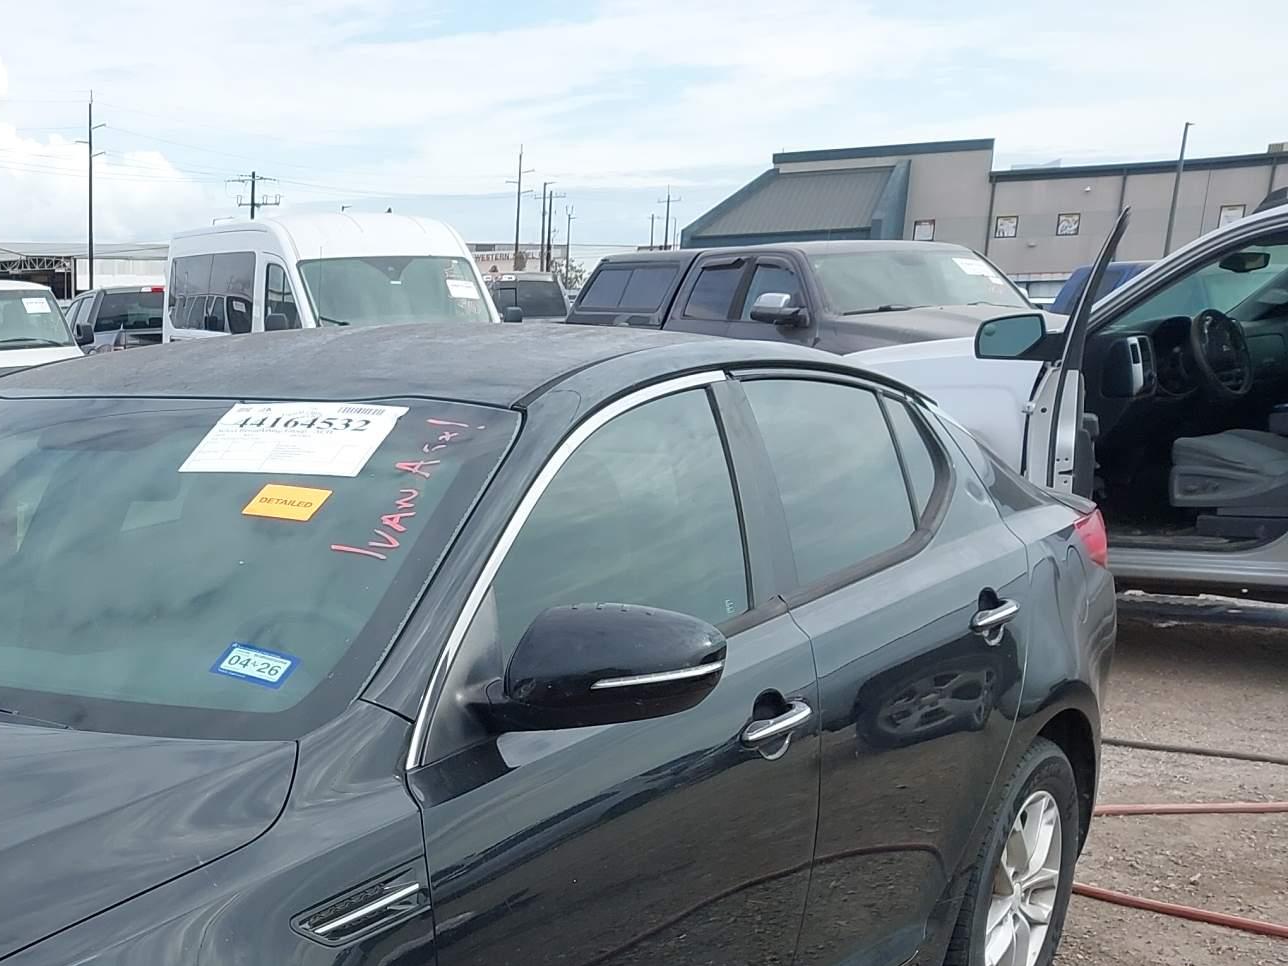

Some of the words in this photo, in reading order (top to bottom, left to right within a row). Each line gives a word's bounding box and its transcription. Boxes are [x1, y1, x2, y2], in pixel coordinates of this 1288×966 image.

[474, 251, 510, 261] WESTERN
[223, 416, 372, 432] 44164532
[259, 496, 313, 508] DETAILED
[228, 655, 251, 668] 04
[256, 662, 282, 677] 26
